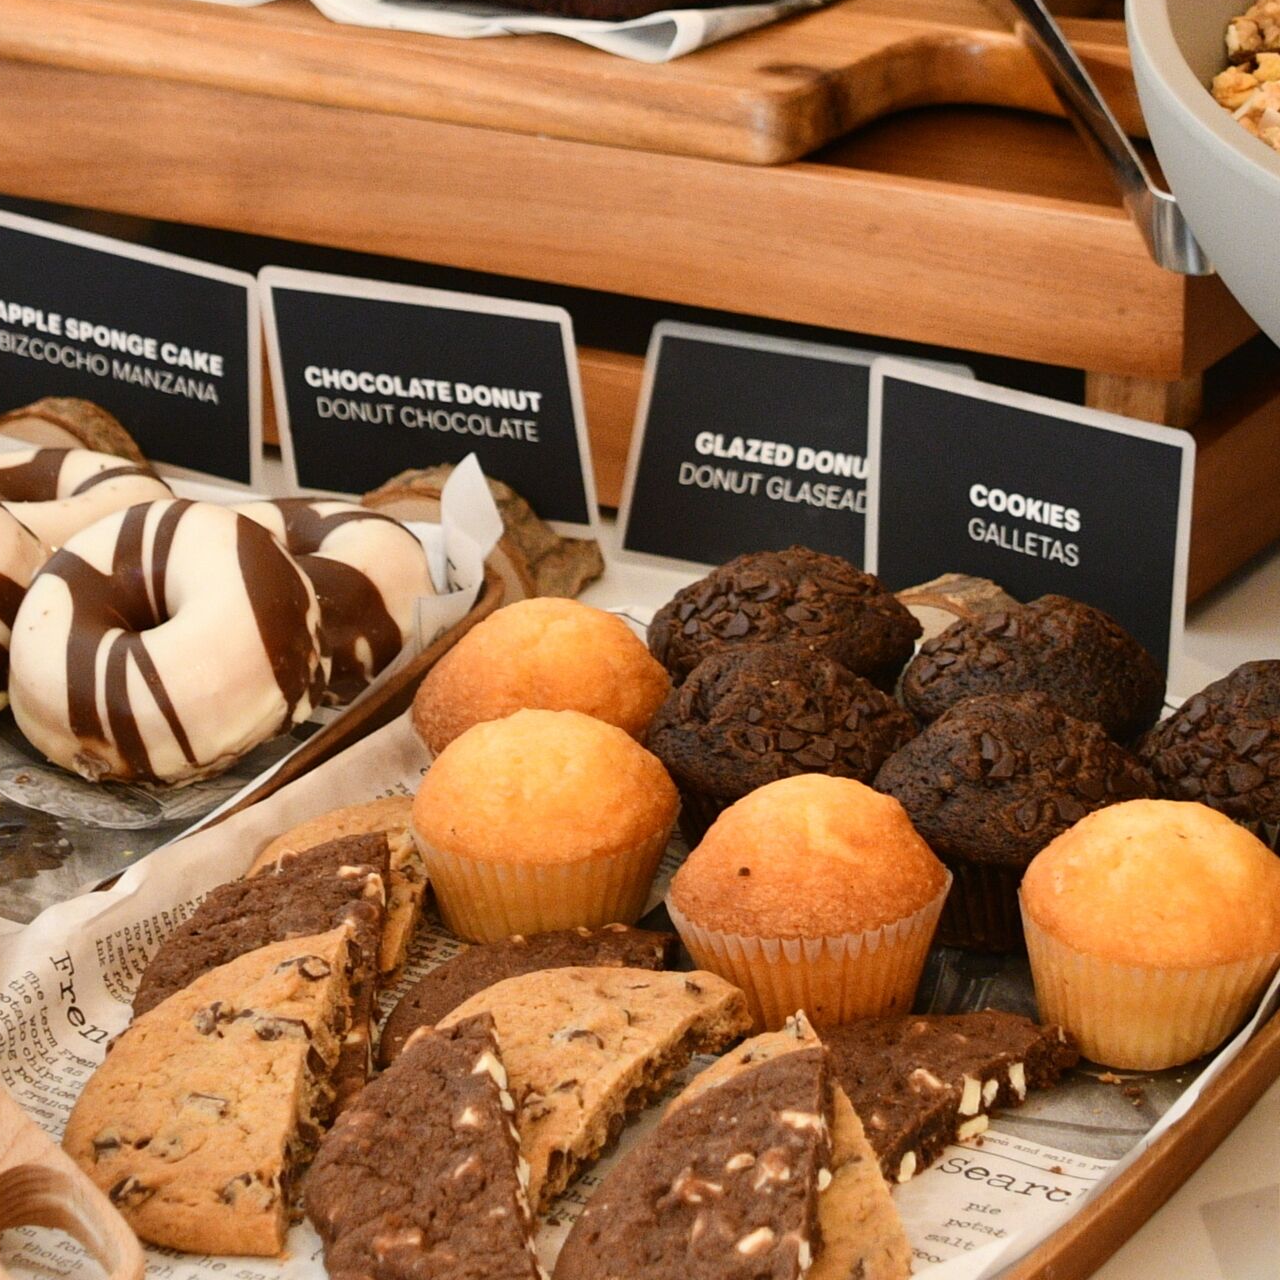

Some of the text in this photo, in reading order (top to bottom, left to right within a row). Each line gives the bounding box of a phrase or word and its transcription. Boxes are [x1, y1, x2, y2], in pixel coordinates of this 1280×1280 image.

[64, 316, 159, 359] SPONGE
[160, 342, 225, 377] CAKE
[112, 361, 219, 406] MANZANA
[304, 365, 542, 414] CHOCOLATE DONUT
[315, 395, 541, 444] DONUT CHOCOLATE
[694, 431, 869, 479] GLAZED DONU
[678, 461, 869, 515] DONUT GLASEAD
[968, 483, 1082, 533] COOKIES
[967, 517, 1081, 568] GALLETAS
[124, 927, 135, 953] old
[143, 920, 153, 946] are
[117, 947, 133, 980] more
[8, 980, 32, 1004] the
[29, 1014, 59, 1065] world
[22, 970, 45, 1001] The
[40, 1006, 59, 1048] term
[57, 1048, 98, 1069] Fren
[1013, 1143, 1040, 1156] and
[1042, 1153, 1073, 1165] salt
[961, 1200, 1002, 1216] pie
[924, 1232, 976, 1252] salt
